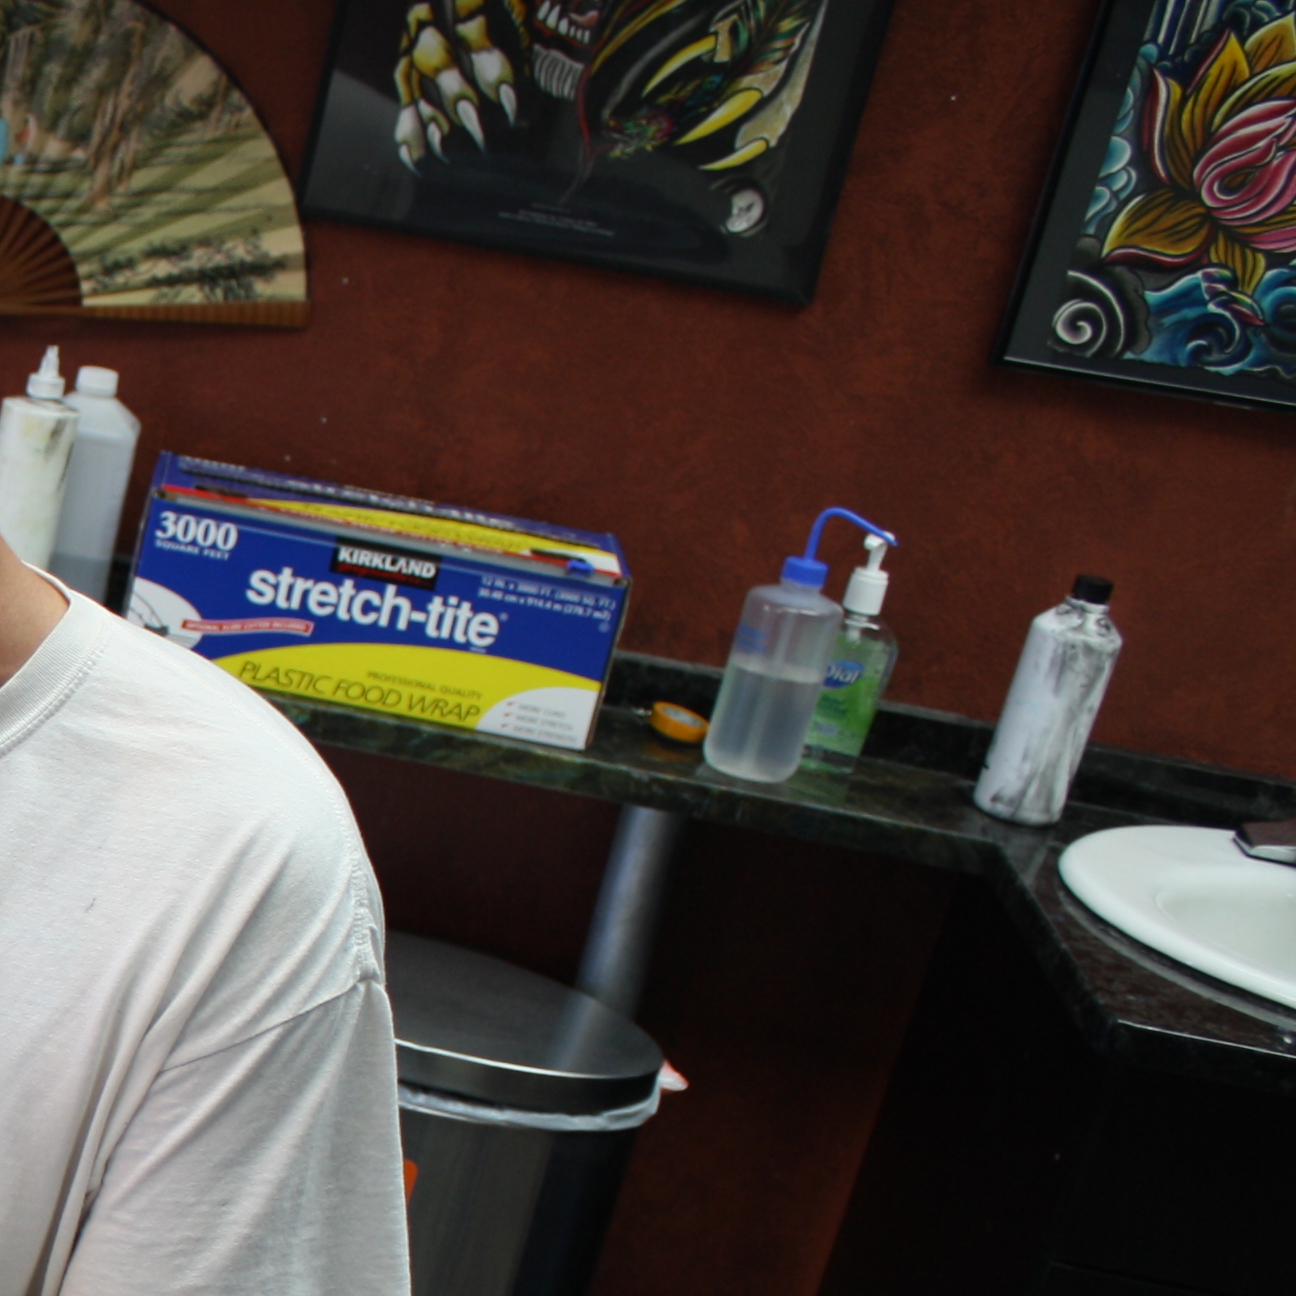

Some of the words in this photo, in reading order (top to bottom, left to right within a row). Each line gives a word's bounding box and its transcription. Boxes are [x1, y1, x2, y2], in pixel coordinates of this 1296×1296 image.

[155, 511, 238, 551] 3000
[155, 538, 201, 556] SQUARE
[203, 547, 231, 561] FEET
[337, 546, 436, 579] KIRKLAND
[246, 566, 499, 648] stretch-tite
[239, 660, 332, 696] PLASTIC
[333, 680, 403, 708] FOOD
[409, 694, 481, 722] WRAP
[367, 671, 437, 691] PROFESSIONAL
[440, 684, 484, 700] QUALITY
